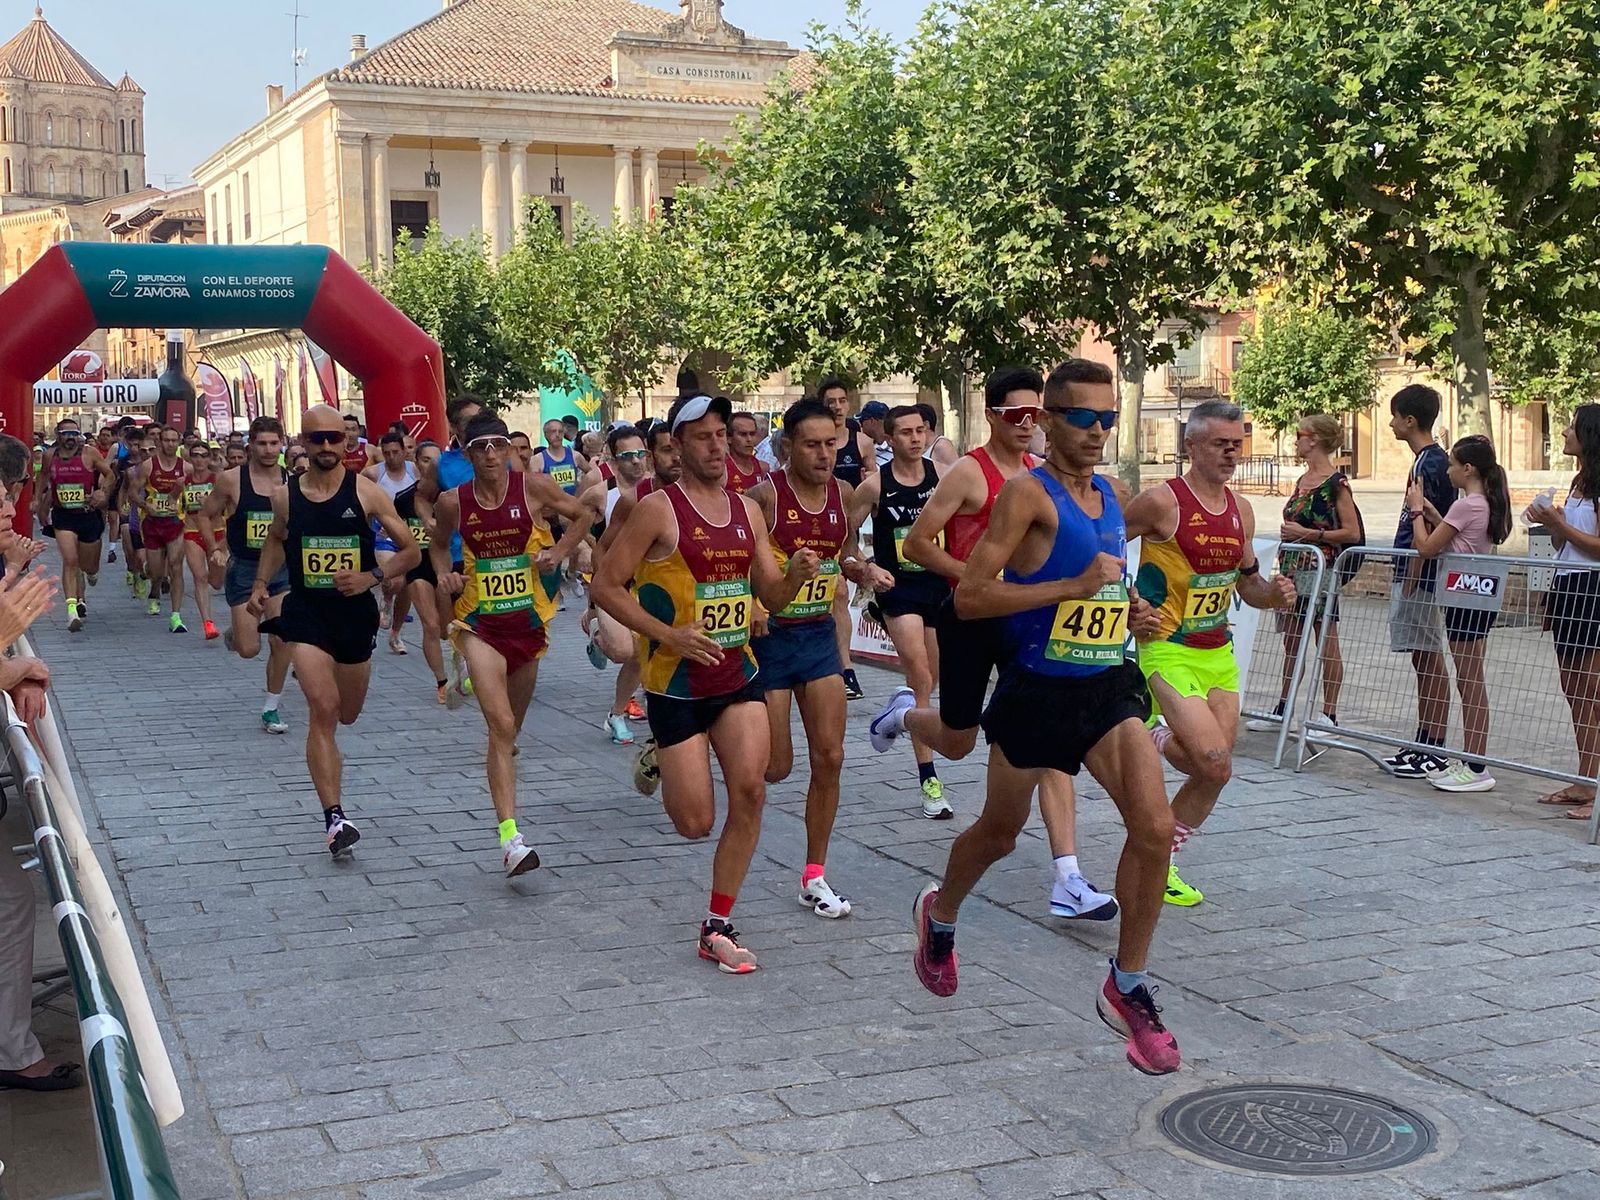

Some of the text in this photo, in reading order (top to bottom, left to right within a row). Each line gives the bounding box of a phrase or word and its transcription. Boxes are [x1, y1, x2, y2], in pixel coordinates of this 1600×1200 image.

[657, 66, 752, 80] CASA CONSISTORIAL
[202, 276, 293, 285] CON EL DEPORTE
[134, 287, 190, 298] ZAMORA
[202, 289, 295, 298] GANAMOS TODOS
[63, 372, 87, 380] TORO
[69, 388, 87, 403] DE
[93, 384, 137, 403] TORO
[554, 471, 573, 482] 1304
[59, 490, 80, 501] 1322
[486, 540, 510, 549] VINO
[493, 546, 519, 556] TORO
[1209, 548, 1233, 556] VINO
[308, 553, 354, 573] 625
[714, 563, 737, 573] VINO
[706, 574, 717, 582] DE
[482, 572, 527, 598] 1205
[804, 579, 829, 602] 15
[496, 602, 513, 610] CAJA
[702, 601, 746, 632] 628
[1062, 605, 1124, 640] 487
[1072, 648, 1094, 659] CAJA
